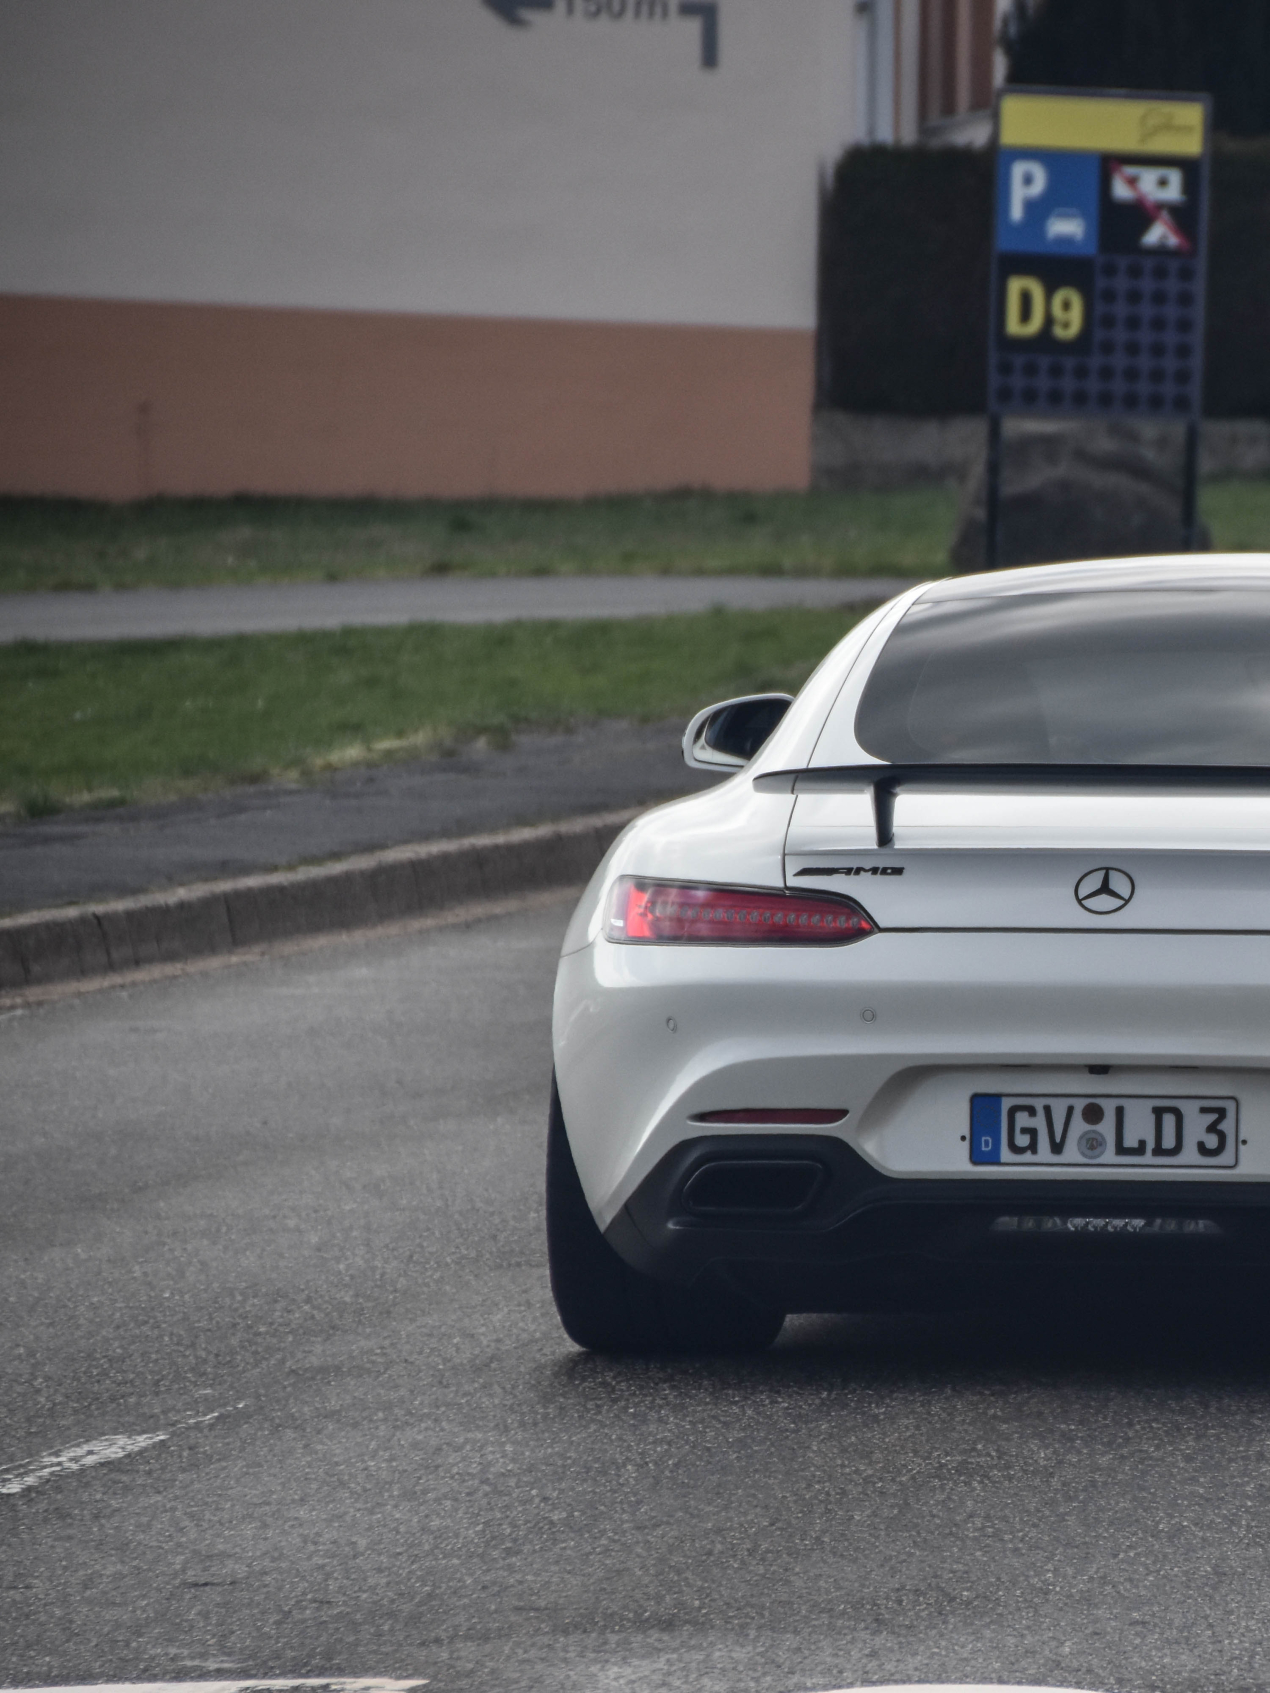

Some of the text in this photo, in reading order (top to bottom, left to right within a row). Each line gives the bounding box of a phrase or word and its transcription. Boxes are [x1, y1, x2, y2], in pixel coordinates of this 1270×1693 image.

[1010, 159, 1046, 223] P
[793, 866, 905, 876] AMG
[981, 1136, 992, 1150] D
[1007, 1104, 1074, 1155] GV
